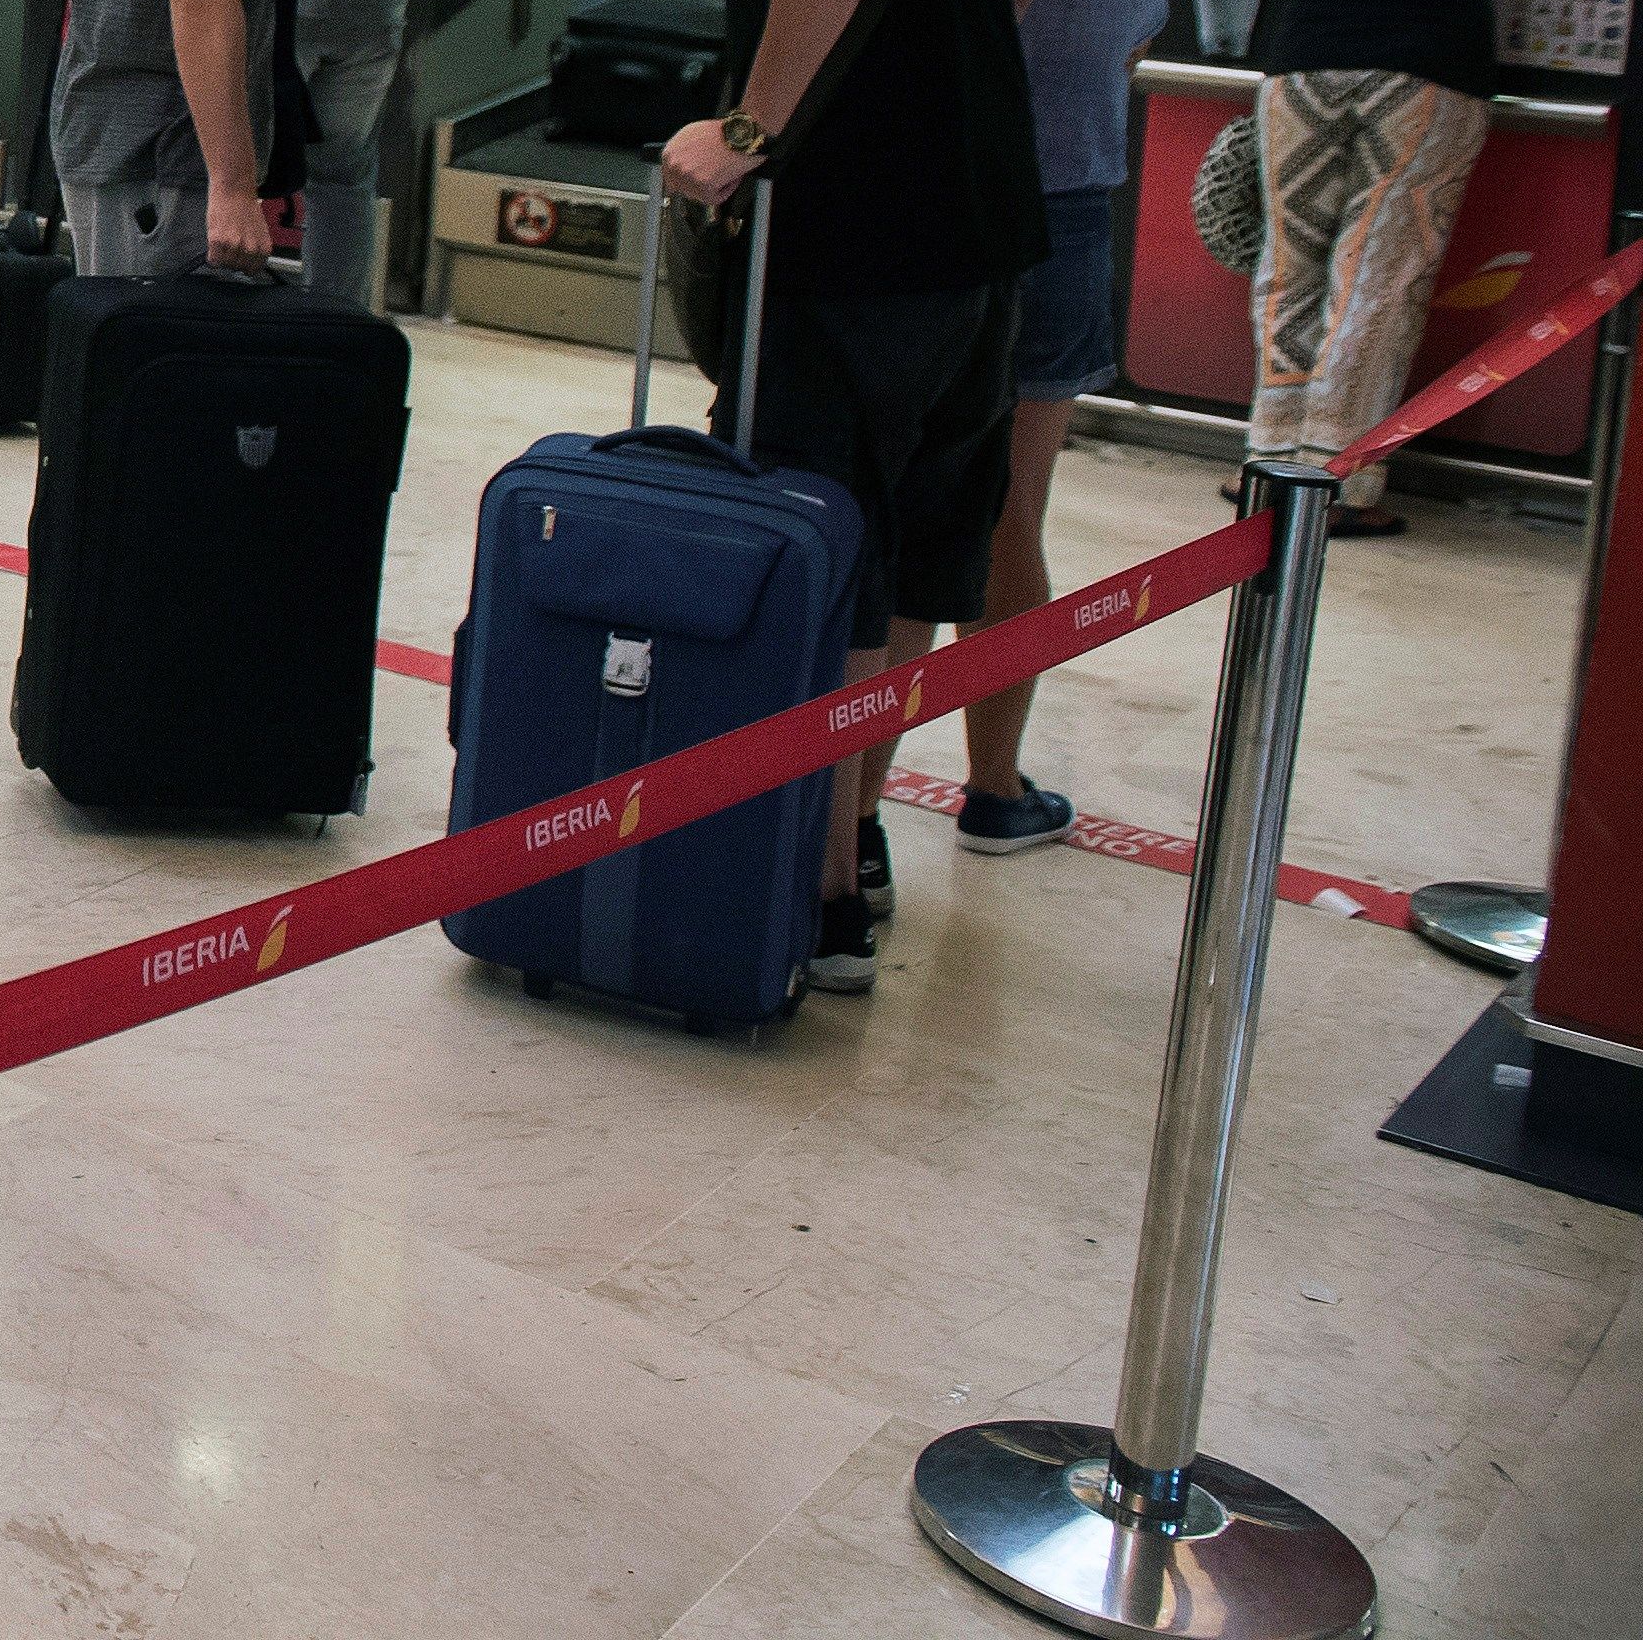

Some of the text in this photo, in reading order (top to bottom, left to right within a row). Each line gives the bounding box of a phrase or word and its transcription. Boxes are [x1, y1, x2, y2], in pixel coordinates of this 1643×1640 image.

[1073, 588, 1131, 630] IBERIA
[828, 685, 899, 733] IBERIA
[525, 798, 613, 852] IBERIA
[142, 925, 252, 988] IBERIA
